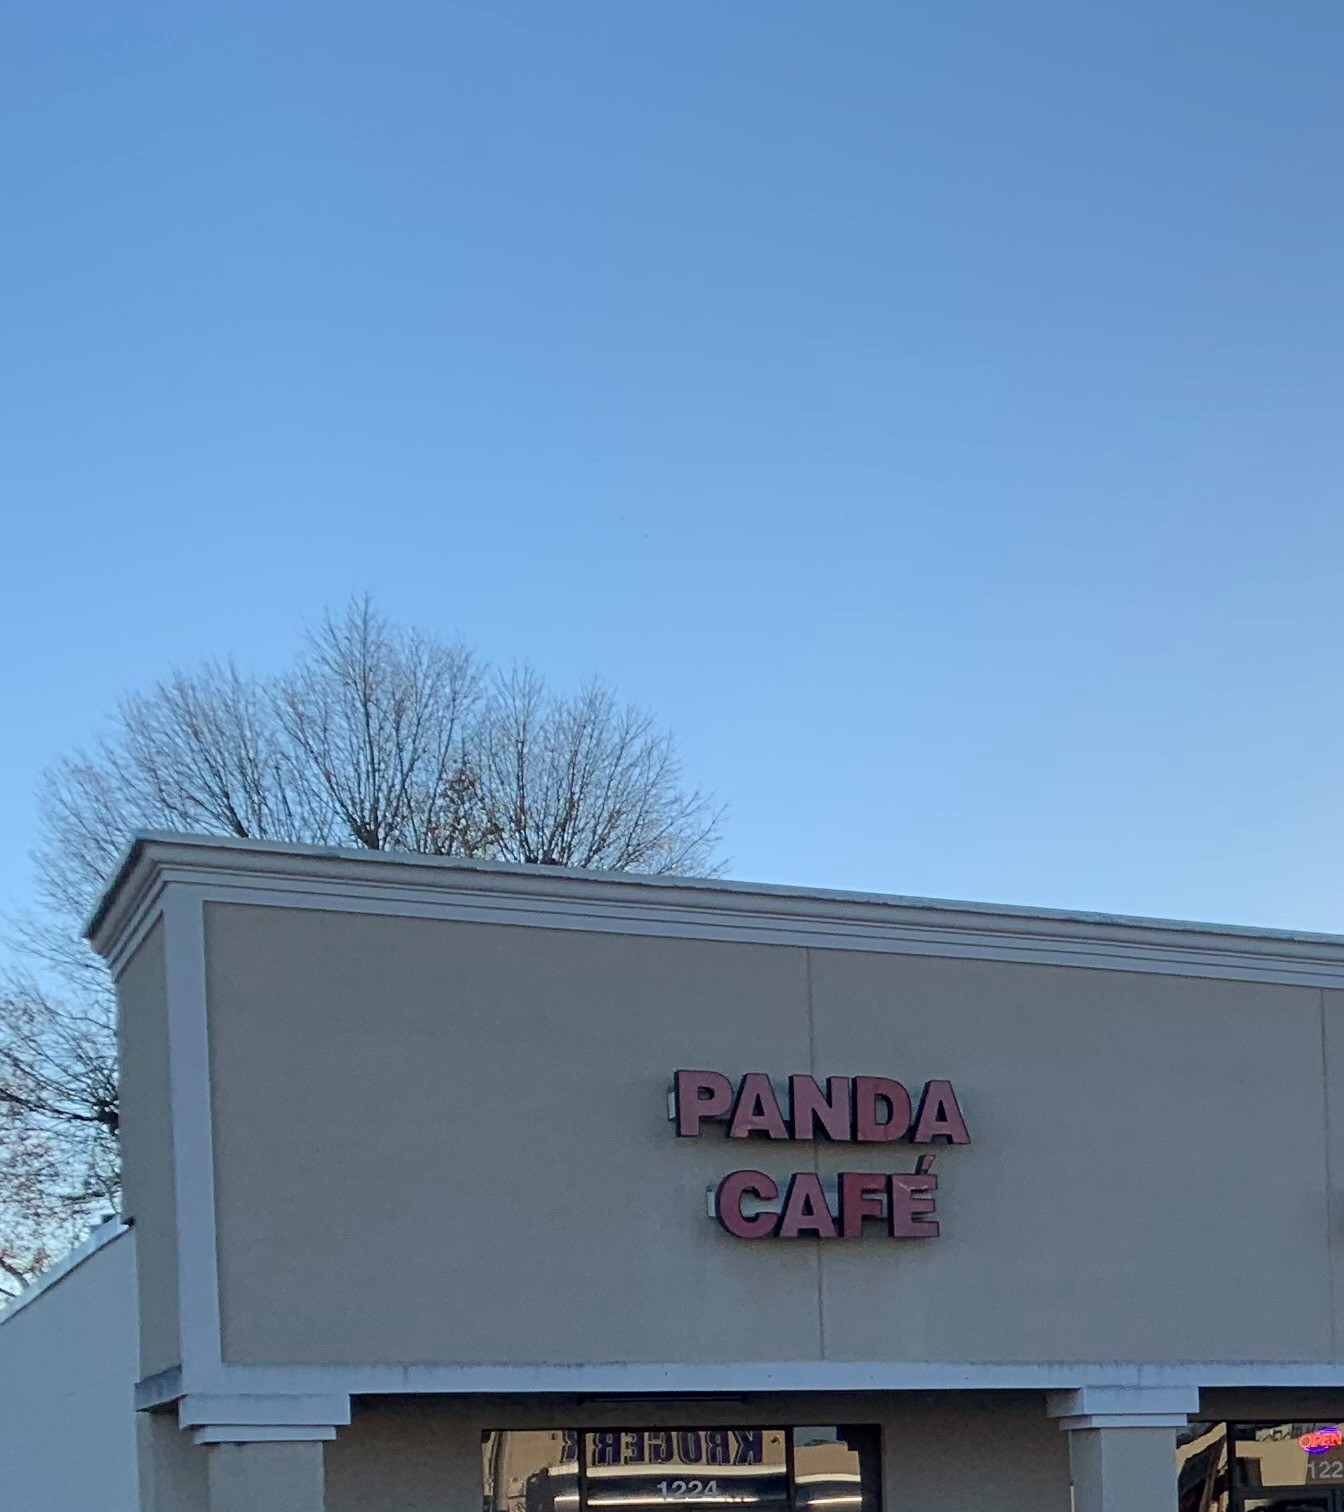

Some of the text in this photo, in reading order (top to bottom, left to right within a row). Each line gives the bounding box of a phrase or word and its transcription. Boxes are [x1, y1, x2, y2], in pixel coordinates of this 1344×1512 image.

[674, 1070, 971, 1145] PANDA
[716, 1154, 940, 1239] CAFÉ
[1298, 1432, 1344, 1449] OPEN
[656, 1480, 719, 1499] 1224
